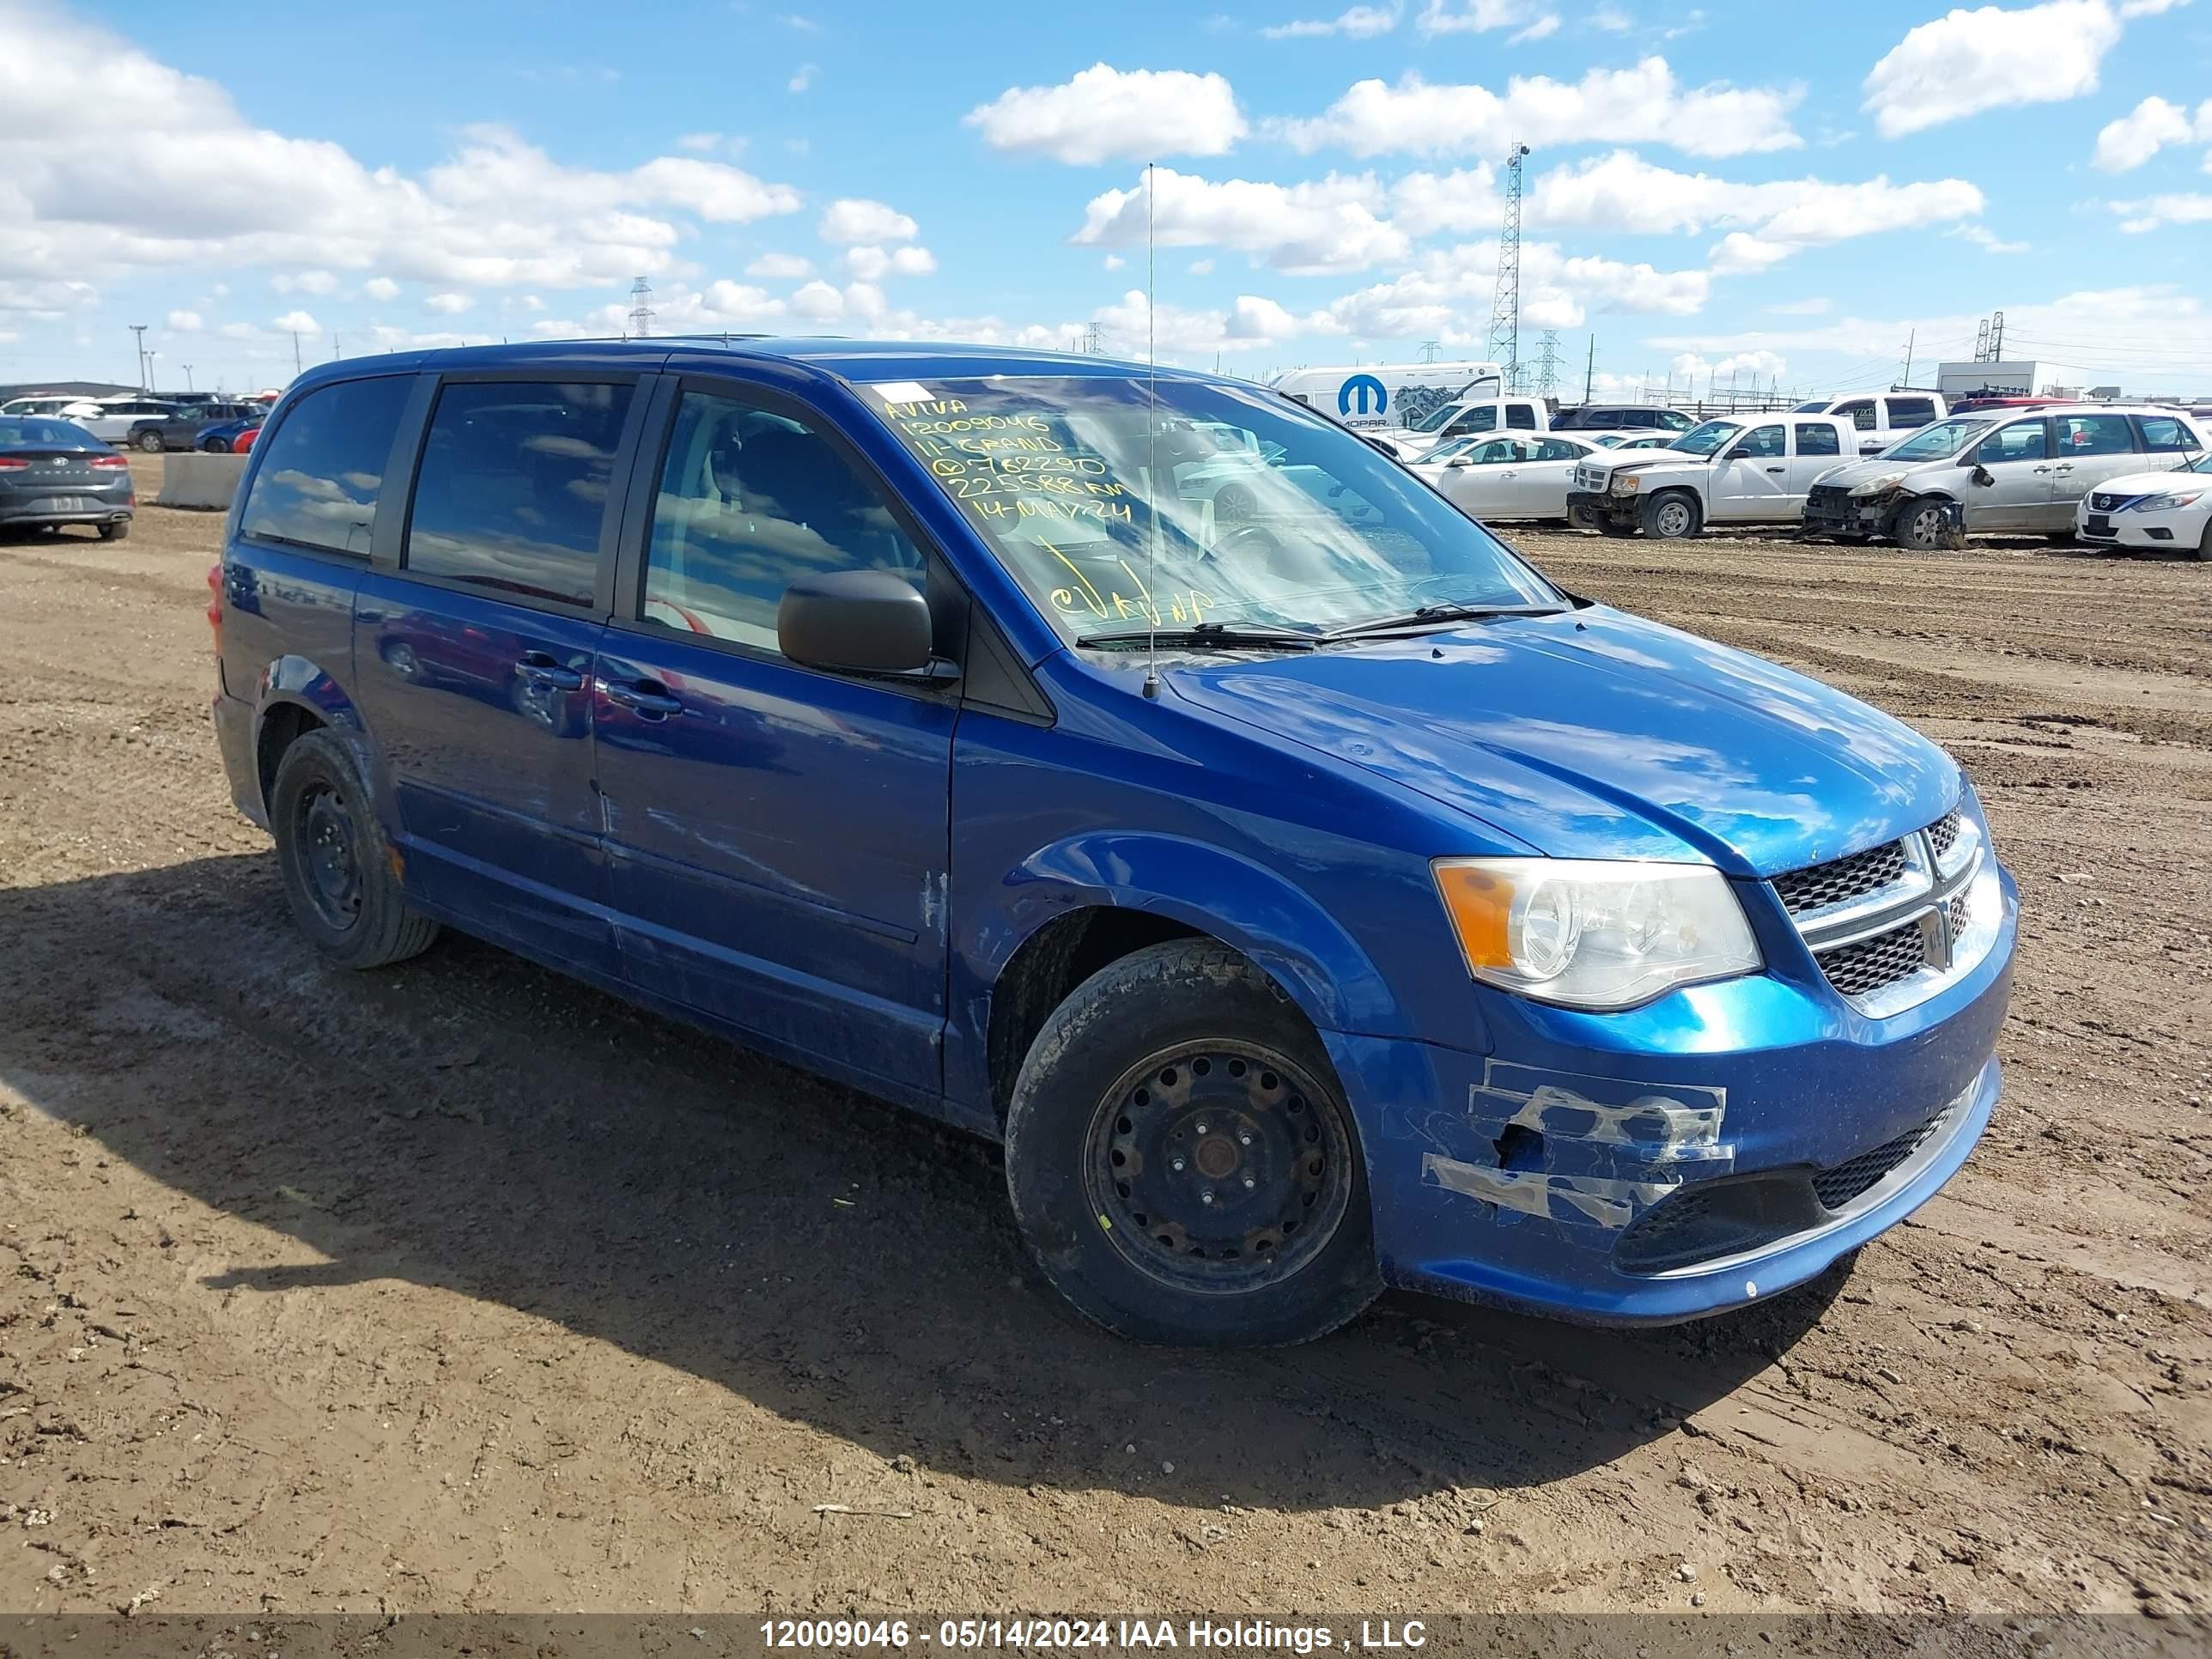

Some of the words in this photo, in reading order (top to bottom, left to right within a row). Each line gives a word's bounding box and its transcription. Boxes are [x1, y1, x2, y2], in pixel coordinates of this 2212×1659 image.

[884, 399, 968, 419] AVIVA
[901, 416, 1049, 436] 12009046
[948, 474, 1084, 497] 225588
